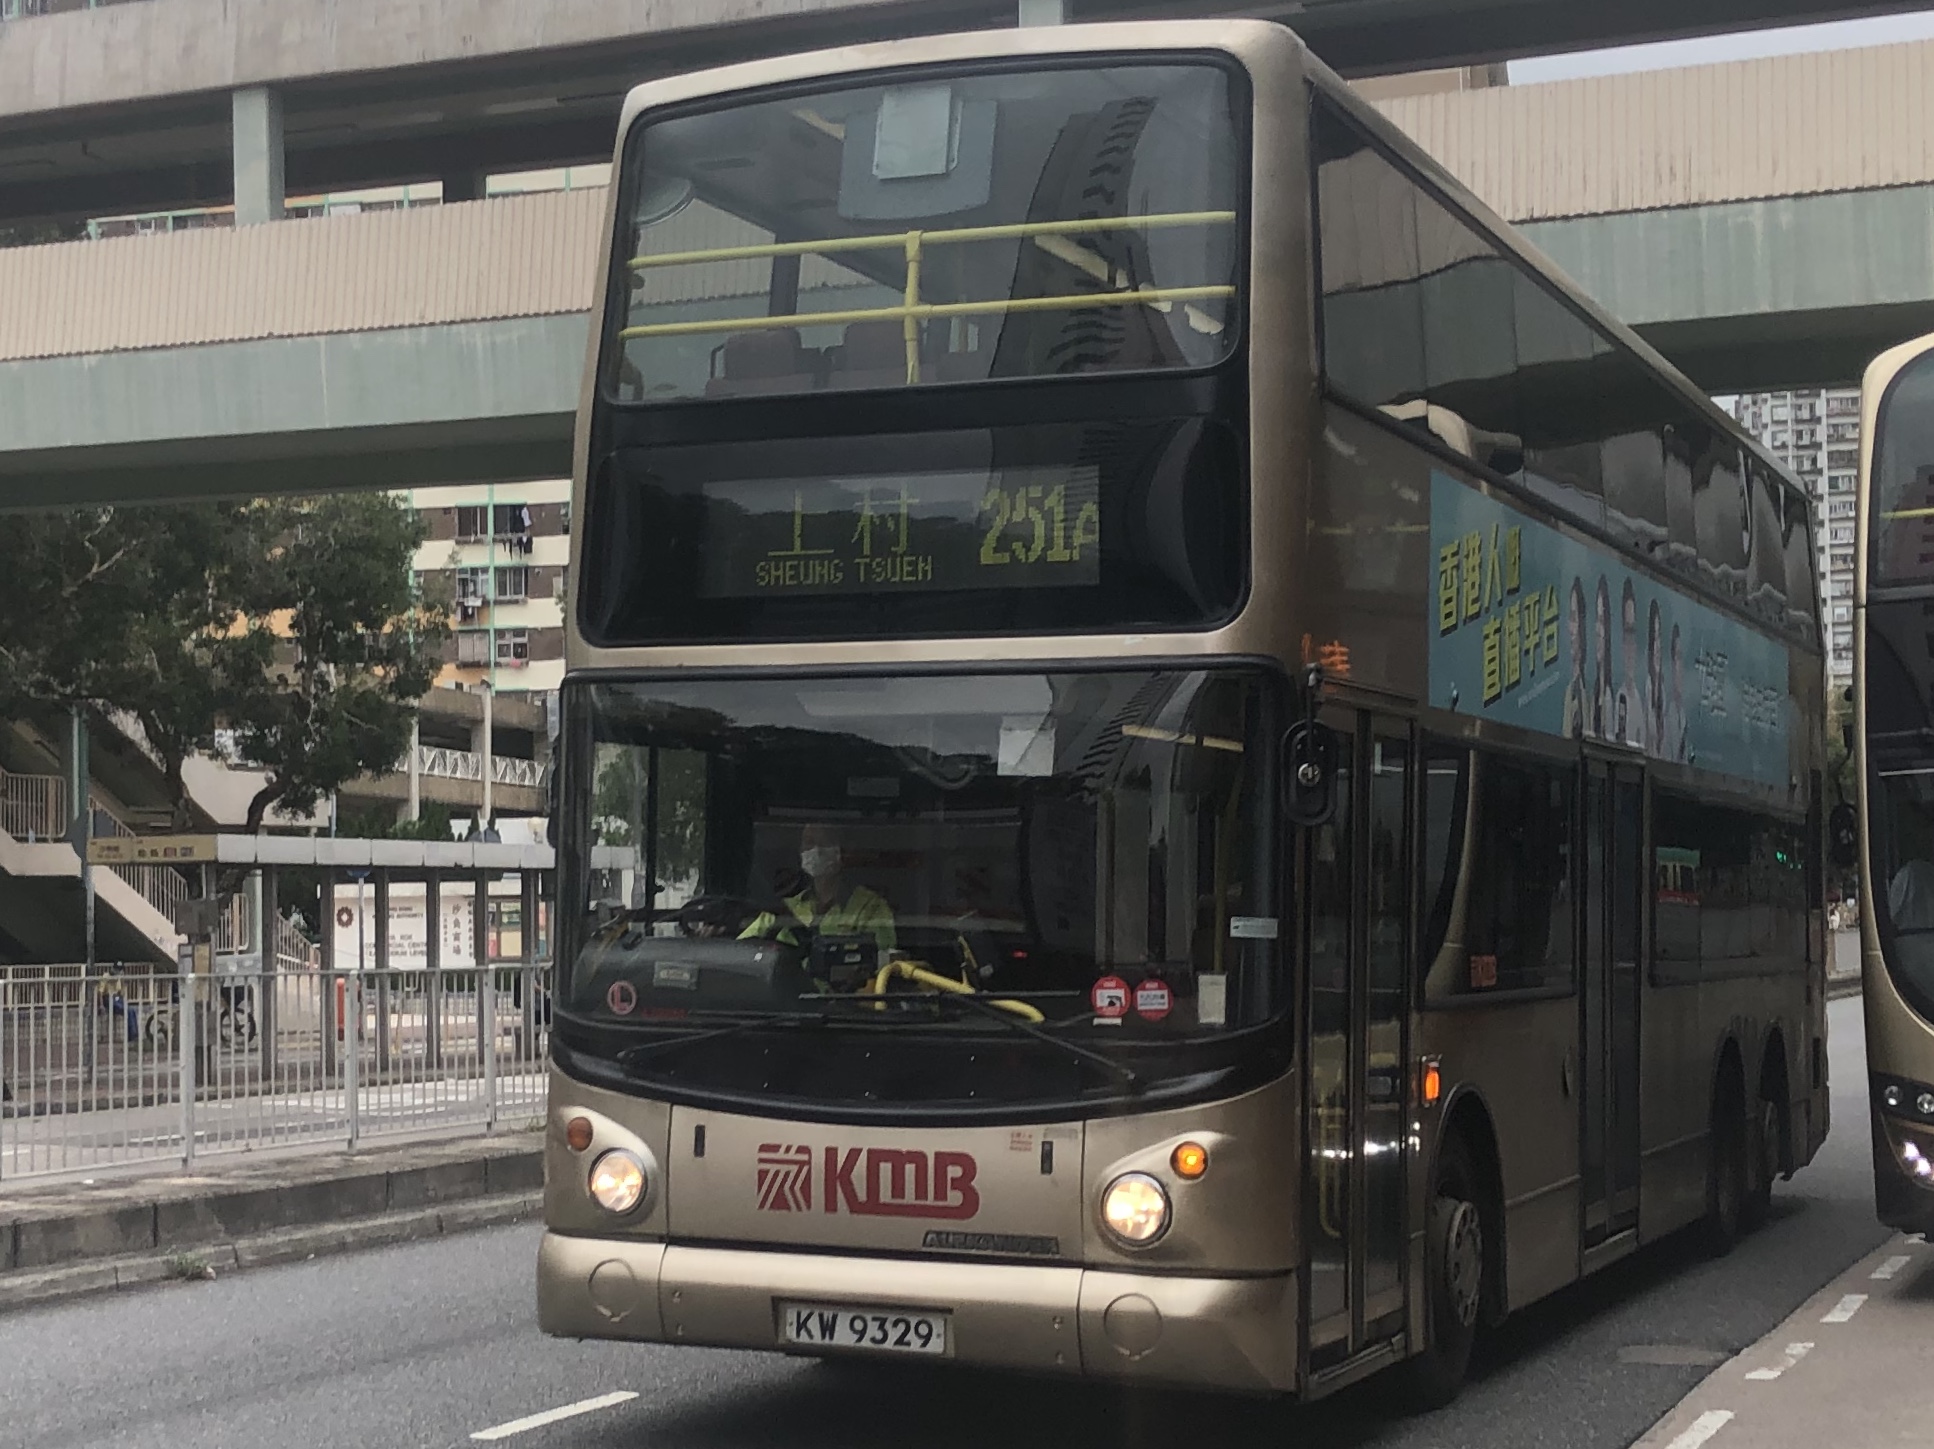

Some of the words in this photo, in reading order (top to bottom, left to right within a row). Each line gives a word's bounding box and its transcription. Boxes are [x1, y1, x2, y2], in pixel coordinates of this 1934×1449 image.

[768, 488, 920, 556] 上村
[980, 485, 1099, 564] 251A
[756, 559, 843, 586] SHEUNG
[854, 554, 932, 583] TSUEN
[824, 1146, 980, 1221] KMB
[796, 1310, 838, 1341] KW
[849, 1315, 933, 1348] 9329
